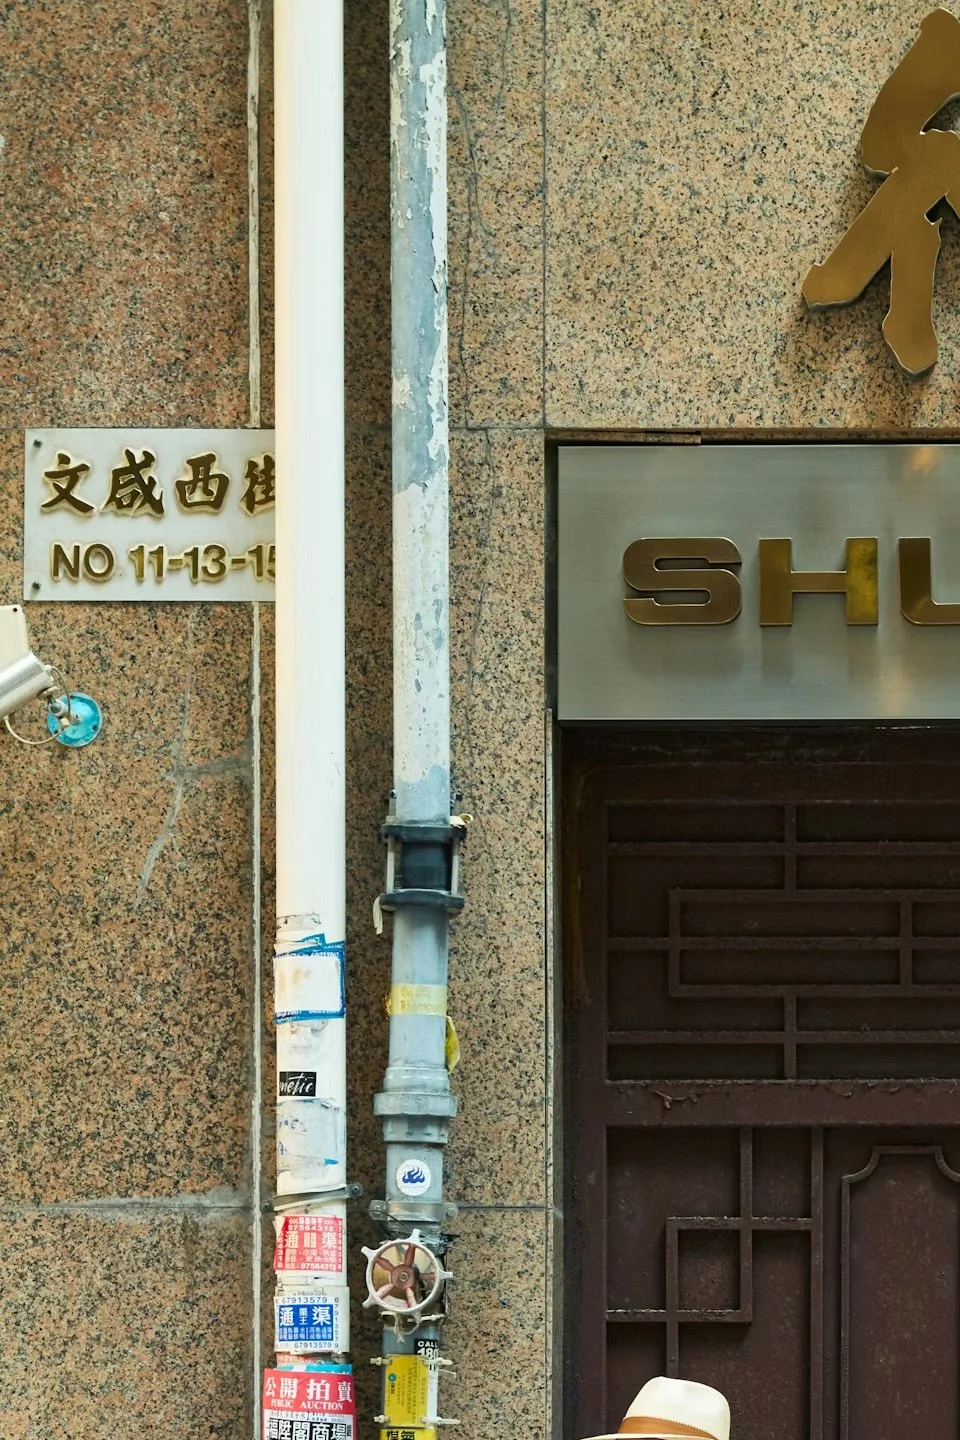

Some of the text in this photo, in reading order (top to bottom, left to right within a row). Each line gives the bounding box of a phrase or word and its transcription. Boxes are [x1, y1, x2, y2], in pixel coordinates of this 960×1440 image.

[51, 543, 116, 580] NO
[279, 1306, 295, 1327] 通
[312, 1305, 331, 1326] 渠
[417, 1340, 437, 1348] CALL
[265, 1376, 352, 1403] 公開拍賣
[271, 1398, 344, 1410] PUBLIC AUCTION
